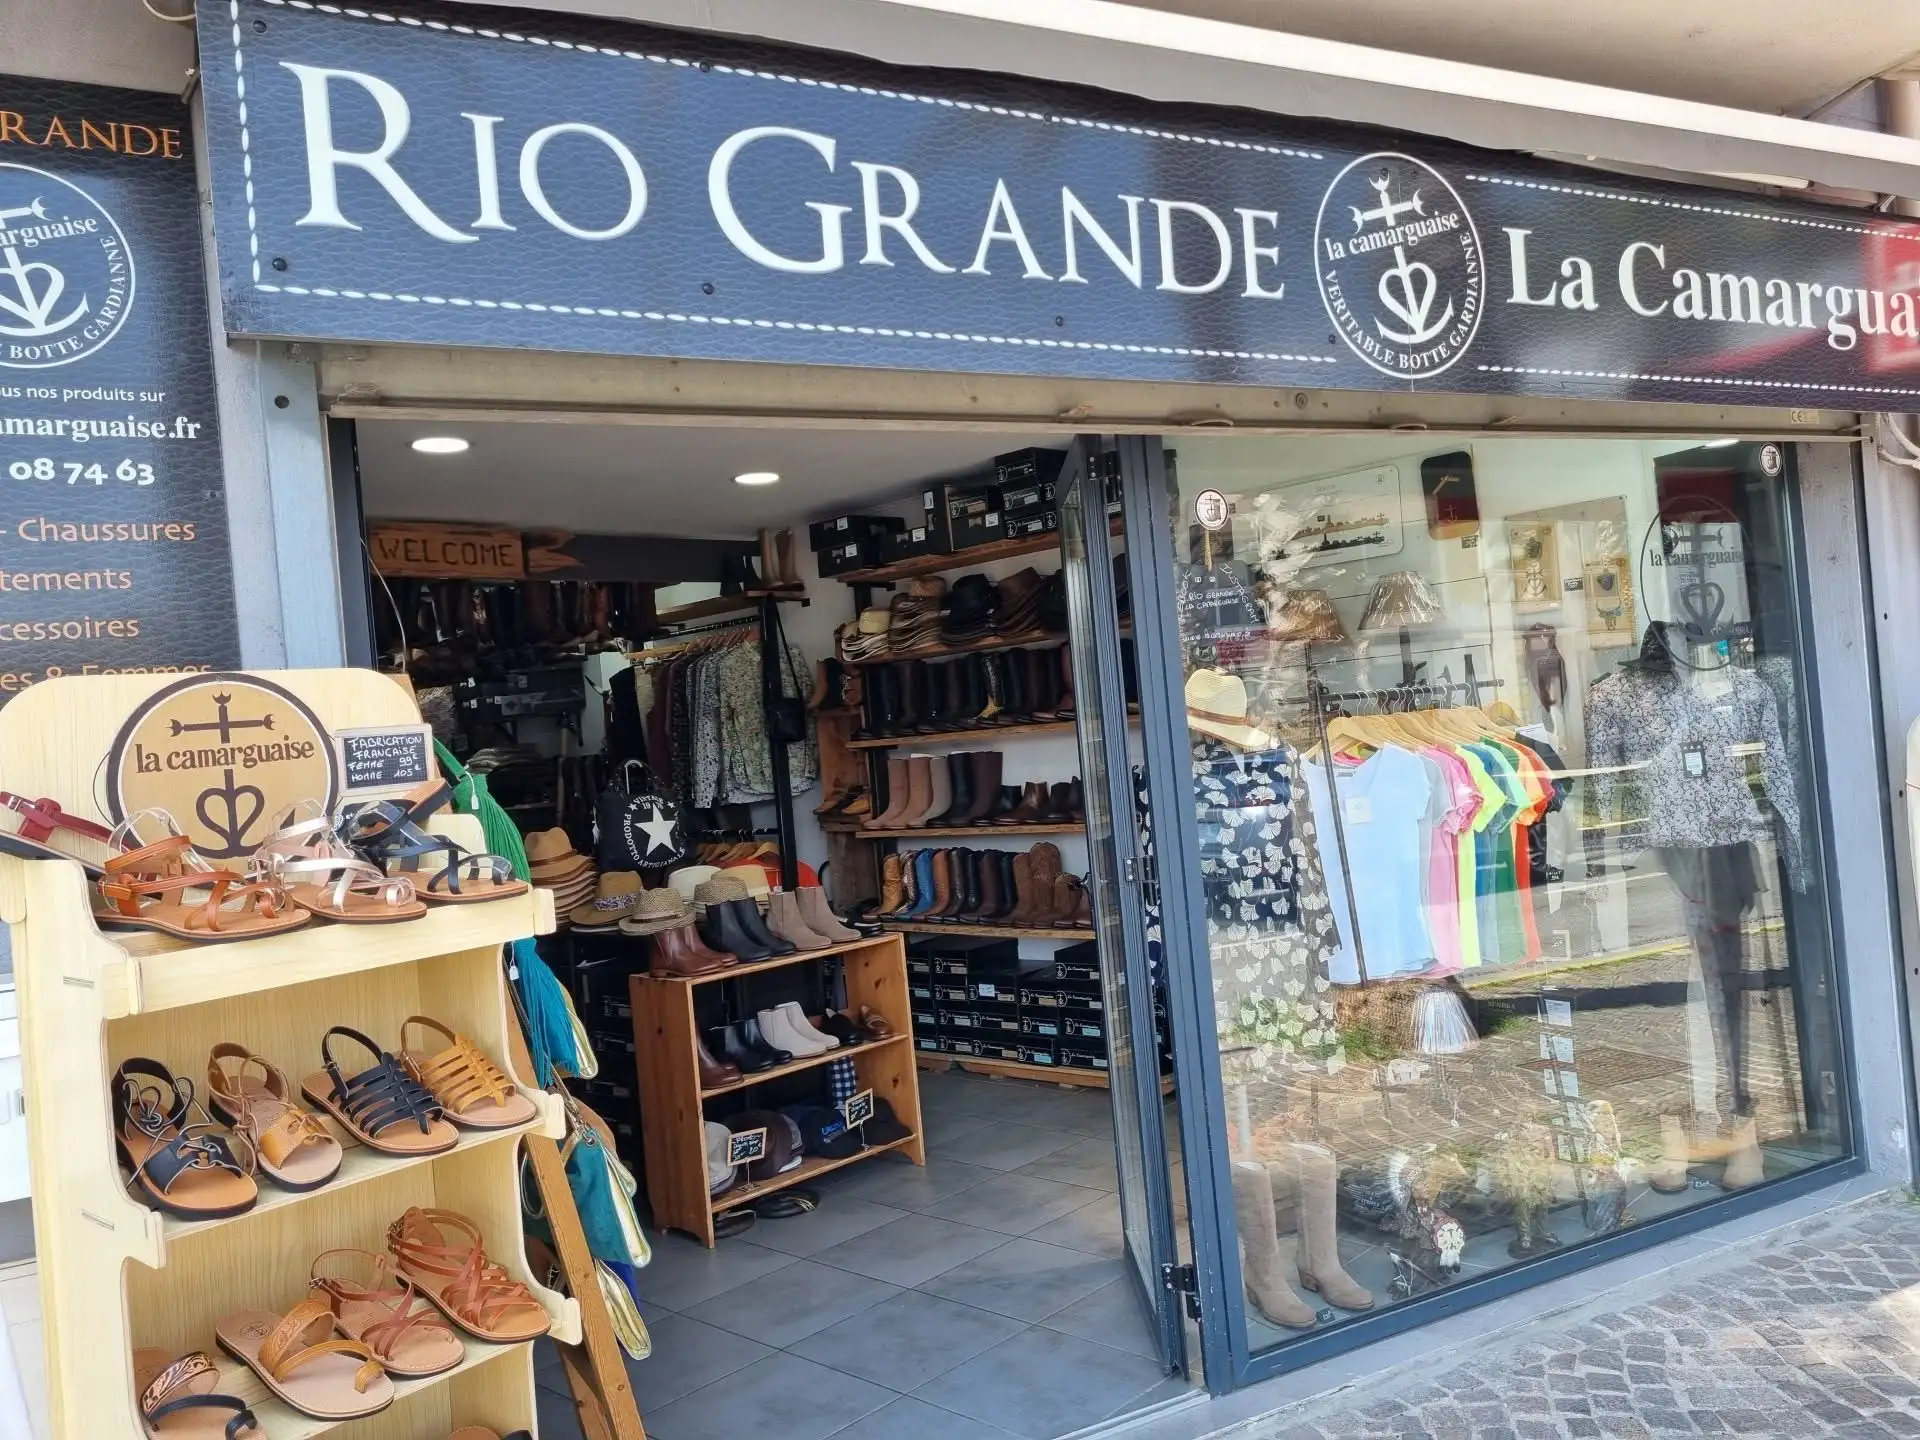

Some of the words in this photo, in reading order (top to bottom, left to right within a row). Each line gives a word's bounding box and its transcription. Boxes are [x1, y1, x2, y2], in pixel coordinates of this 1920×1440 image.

[0, 110, 183, 159] RANDE
[279, 61, 648, 243] RIO
[708, 126, 1285, 299] GRANDE
[1324, 237, 1346, 262] la
[1348, 210, 1460, 255] camarguaise
[1502, 227, 1598, 311] La
[9, 336, 84, 360] BOTTE
[85, 235, 125, 341] GARDIANNE
[1325, 269, 1394, 365] VERITABLE
[1399, 343, 1450, 369] BOTTE
[1450, 232, 1479, 347] GARDIANNE
[0, 386, 21, 398] us
[26, 386, 57, 399] nos
[63, 386, 135, 402] produits
[139, 391, 165, 402] sur
[0, 415, 201, 442] marguaise.fr
[9, 457, 56, 481] 08
[63, 463, 109, 485] 74
[116, 458, 155, 485] 63
[18, 517, 195, 542] Chaussures
[378, 537, 514, 567] WELCOME
[0, 568, 132, 592] tements
[135, 743, 162, 773] la
[166, 735, 315, 771] camarguaise
[348, 760, 384, 771] FEMME
[352, 771, 383, 782] HOMME
